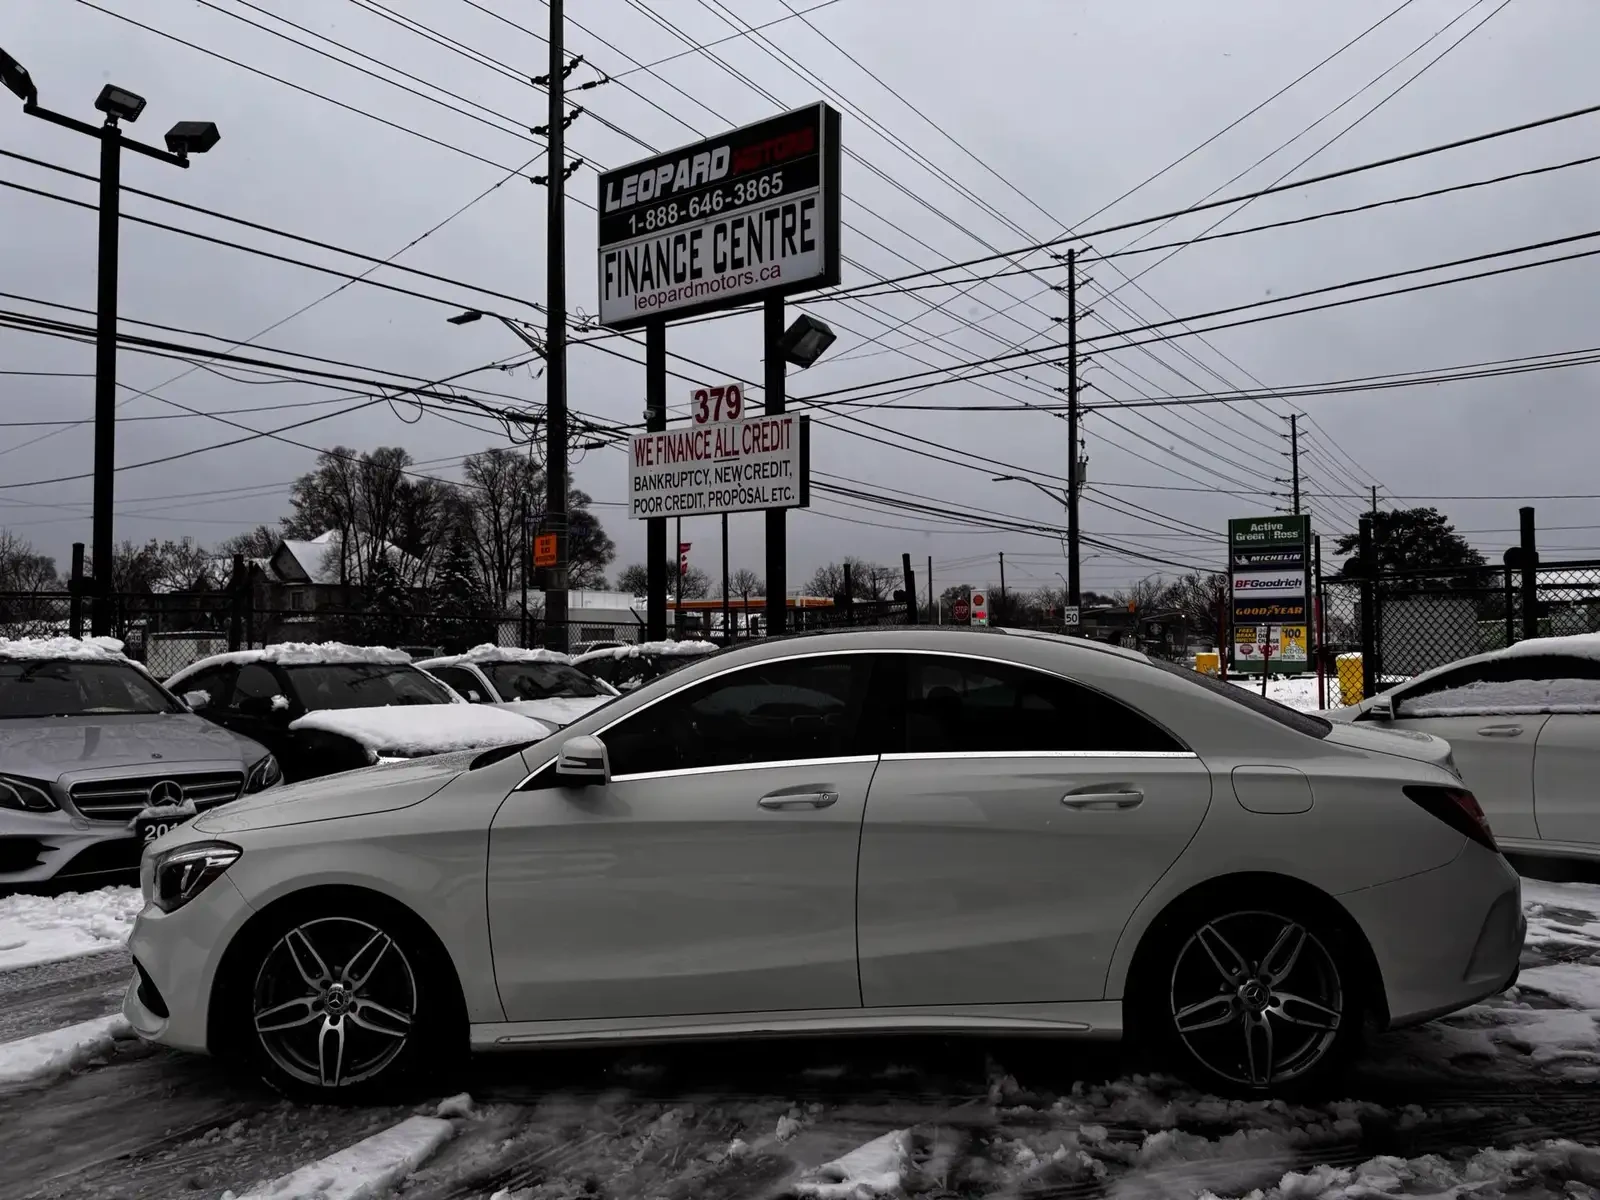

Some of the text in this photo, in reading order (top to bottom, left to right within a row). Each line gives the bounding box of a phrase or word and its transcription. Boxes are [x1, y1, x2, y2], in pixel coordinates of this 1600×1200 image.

[605, 146, 730, 213] LEOPARD
[628, 171, 783, 235] 1-888-646-3865
[605, 198, 816, 301] FINANCE CENTRE
[634, 264, 782, 310] leopardmotors.ca
[694, 385, 742, 424] 379
[634, 418, 793, 468] WE FINANCE ALL CREDIT
[634, 460, 793, 492] BANKRUPTCY, NEW CREDIT,
[634, 496, 662, 515] POOR
[664, 492, 706, 512] CREDIT,
[771, 486, 795, 501] ETC.
[1236, 530, 1299, 541] Green Ross
[1250, 522, 1283, 532] Active
[1250, 554, 1301, 562] MICHELIN
[1235, 578, 1302, 588] BFGoodrich
[955, 606, 968, 614] STOP
[1066, 613, 1078, 623] 50
